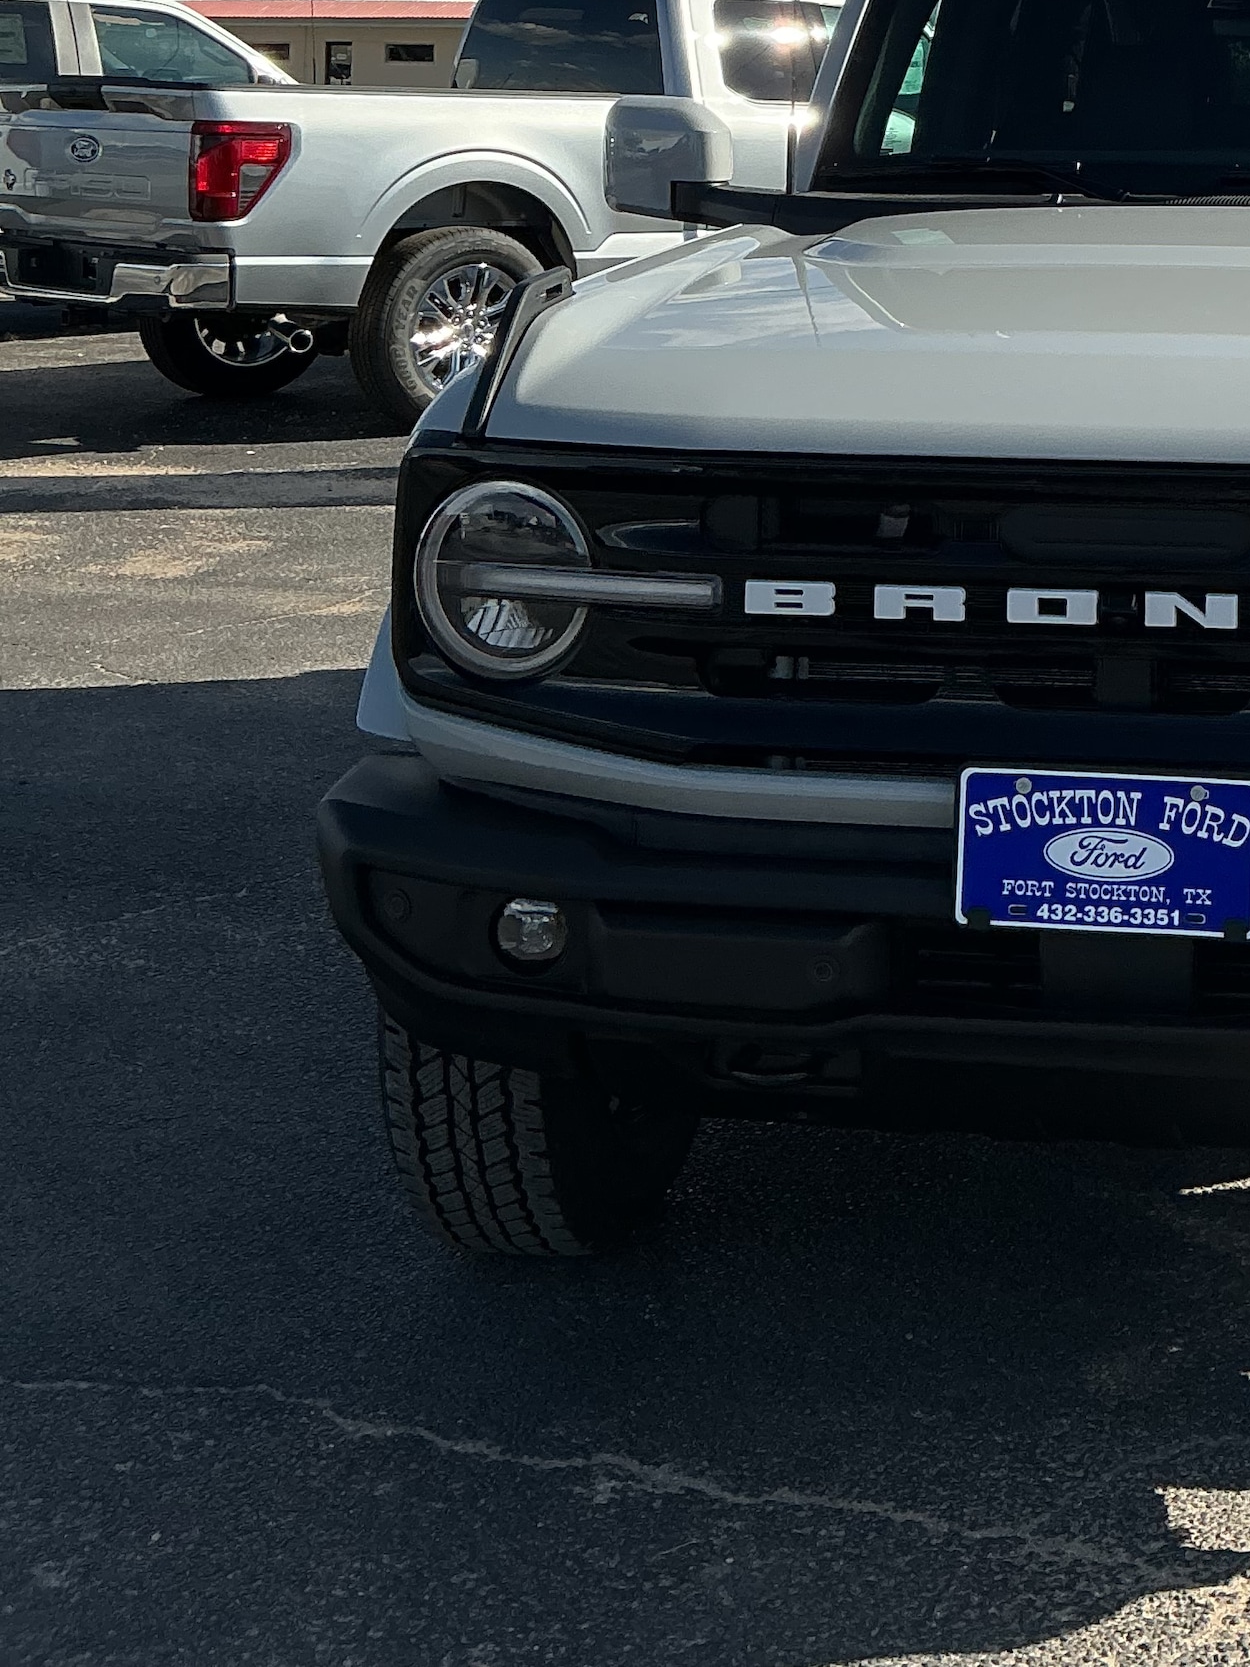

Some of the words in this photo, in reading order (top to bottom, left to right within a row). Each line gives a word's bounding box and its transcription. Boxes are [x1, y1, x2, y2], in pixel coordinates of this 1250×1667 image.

[968, 789, 1142, 836] STOCKTON
[1158, 796, 1250, 848] FORD
[1070, 835, 1147, 869] Ford
[1001, 879, 1054, 897] FORT
[1065, 883, 1171, 905] STOCKTON,
[1183, 888, 1212, 905] TX
[1036, 903, 1180, 926] 432-336-3351
